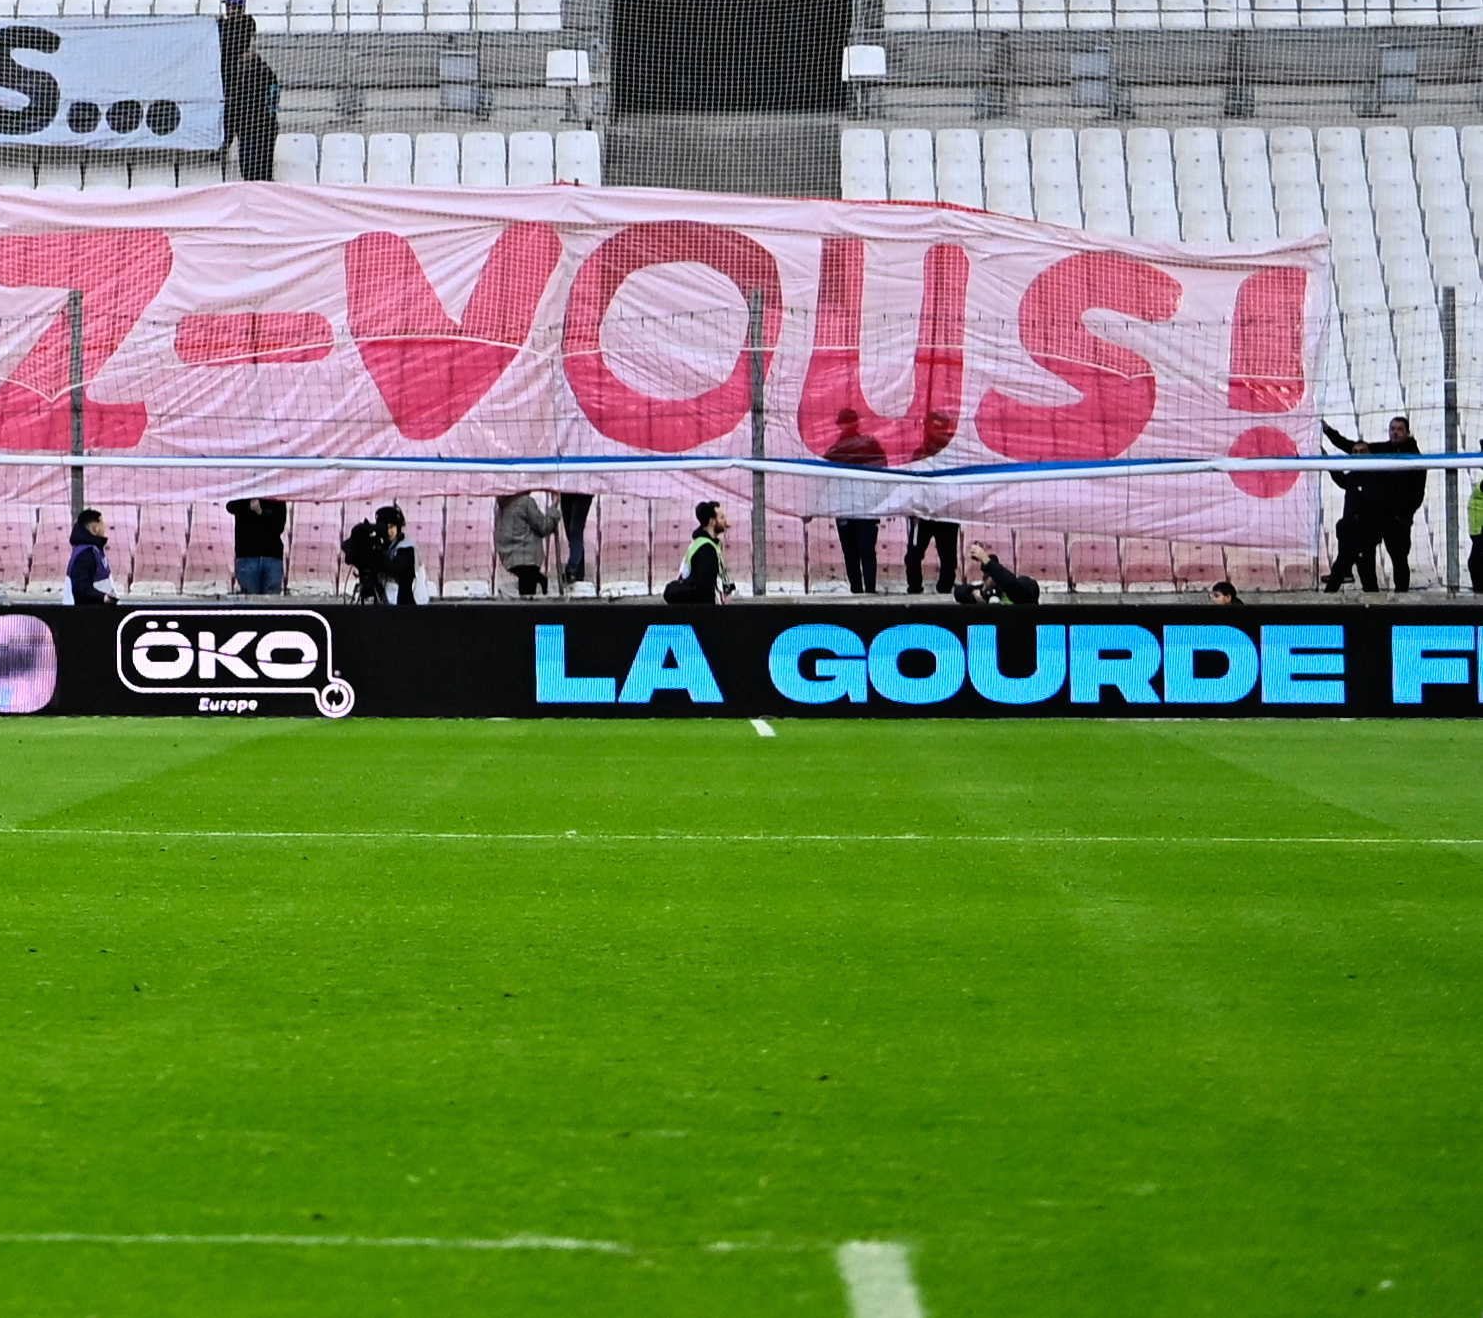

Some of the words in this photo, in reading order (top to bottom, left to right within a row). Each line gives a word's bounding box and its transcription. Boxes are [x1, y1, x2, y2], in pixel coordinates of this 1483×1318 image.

[132, 621, 319, 681] ÖKO
[535, 624, 724, 703] LA
[768, 623, 1347, 704] GOURDE
[198, 697, 258, 712] Europe
